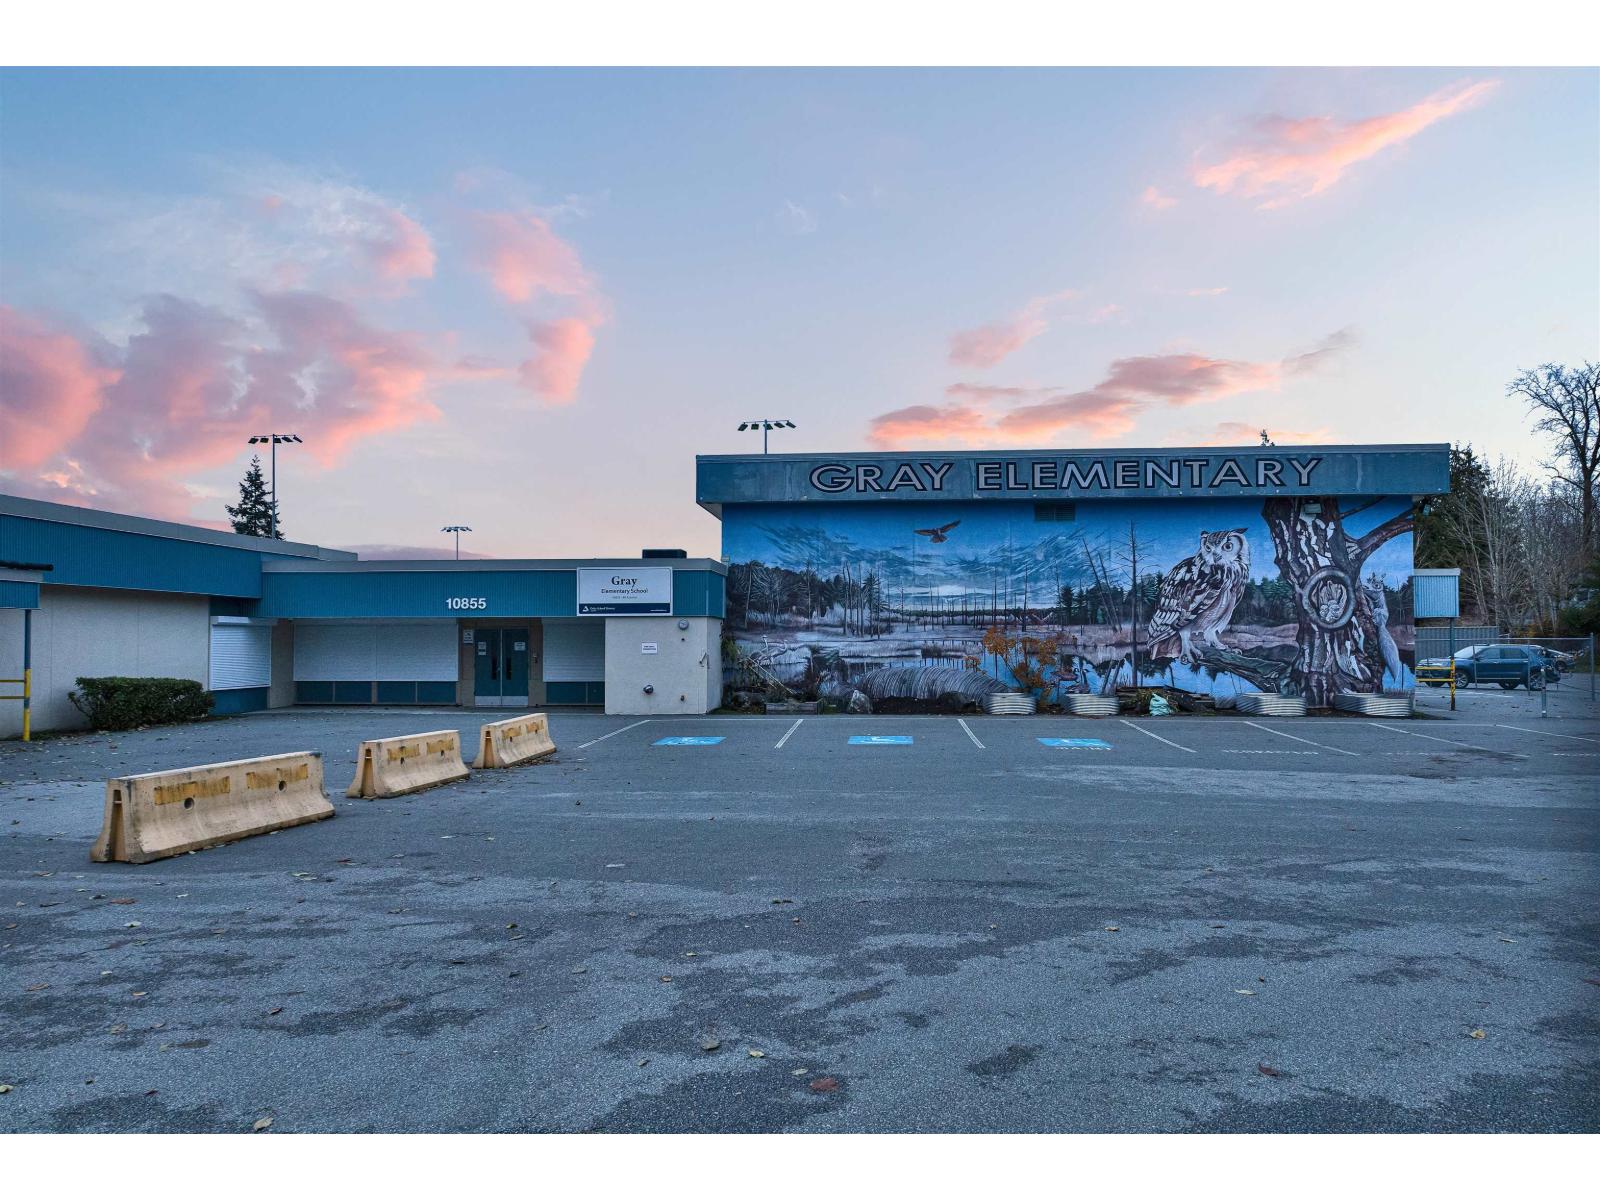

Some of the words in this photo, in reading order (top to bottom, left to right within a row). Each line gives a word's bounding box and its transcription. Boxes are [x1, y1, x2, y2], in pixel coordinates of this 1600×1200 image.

[809, 463, 954, 493] GRAY
[975, 457, 1323, 491] ELEMENTARY
[611, 576, 638, 588] Gray
[445, 597, 487, 610] 10855
